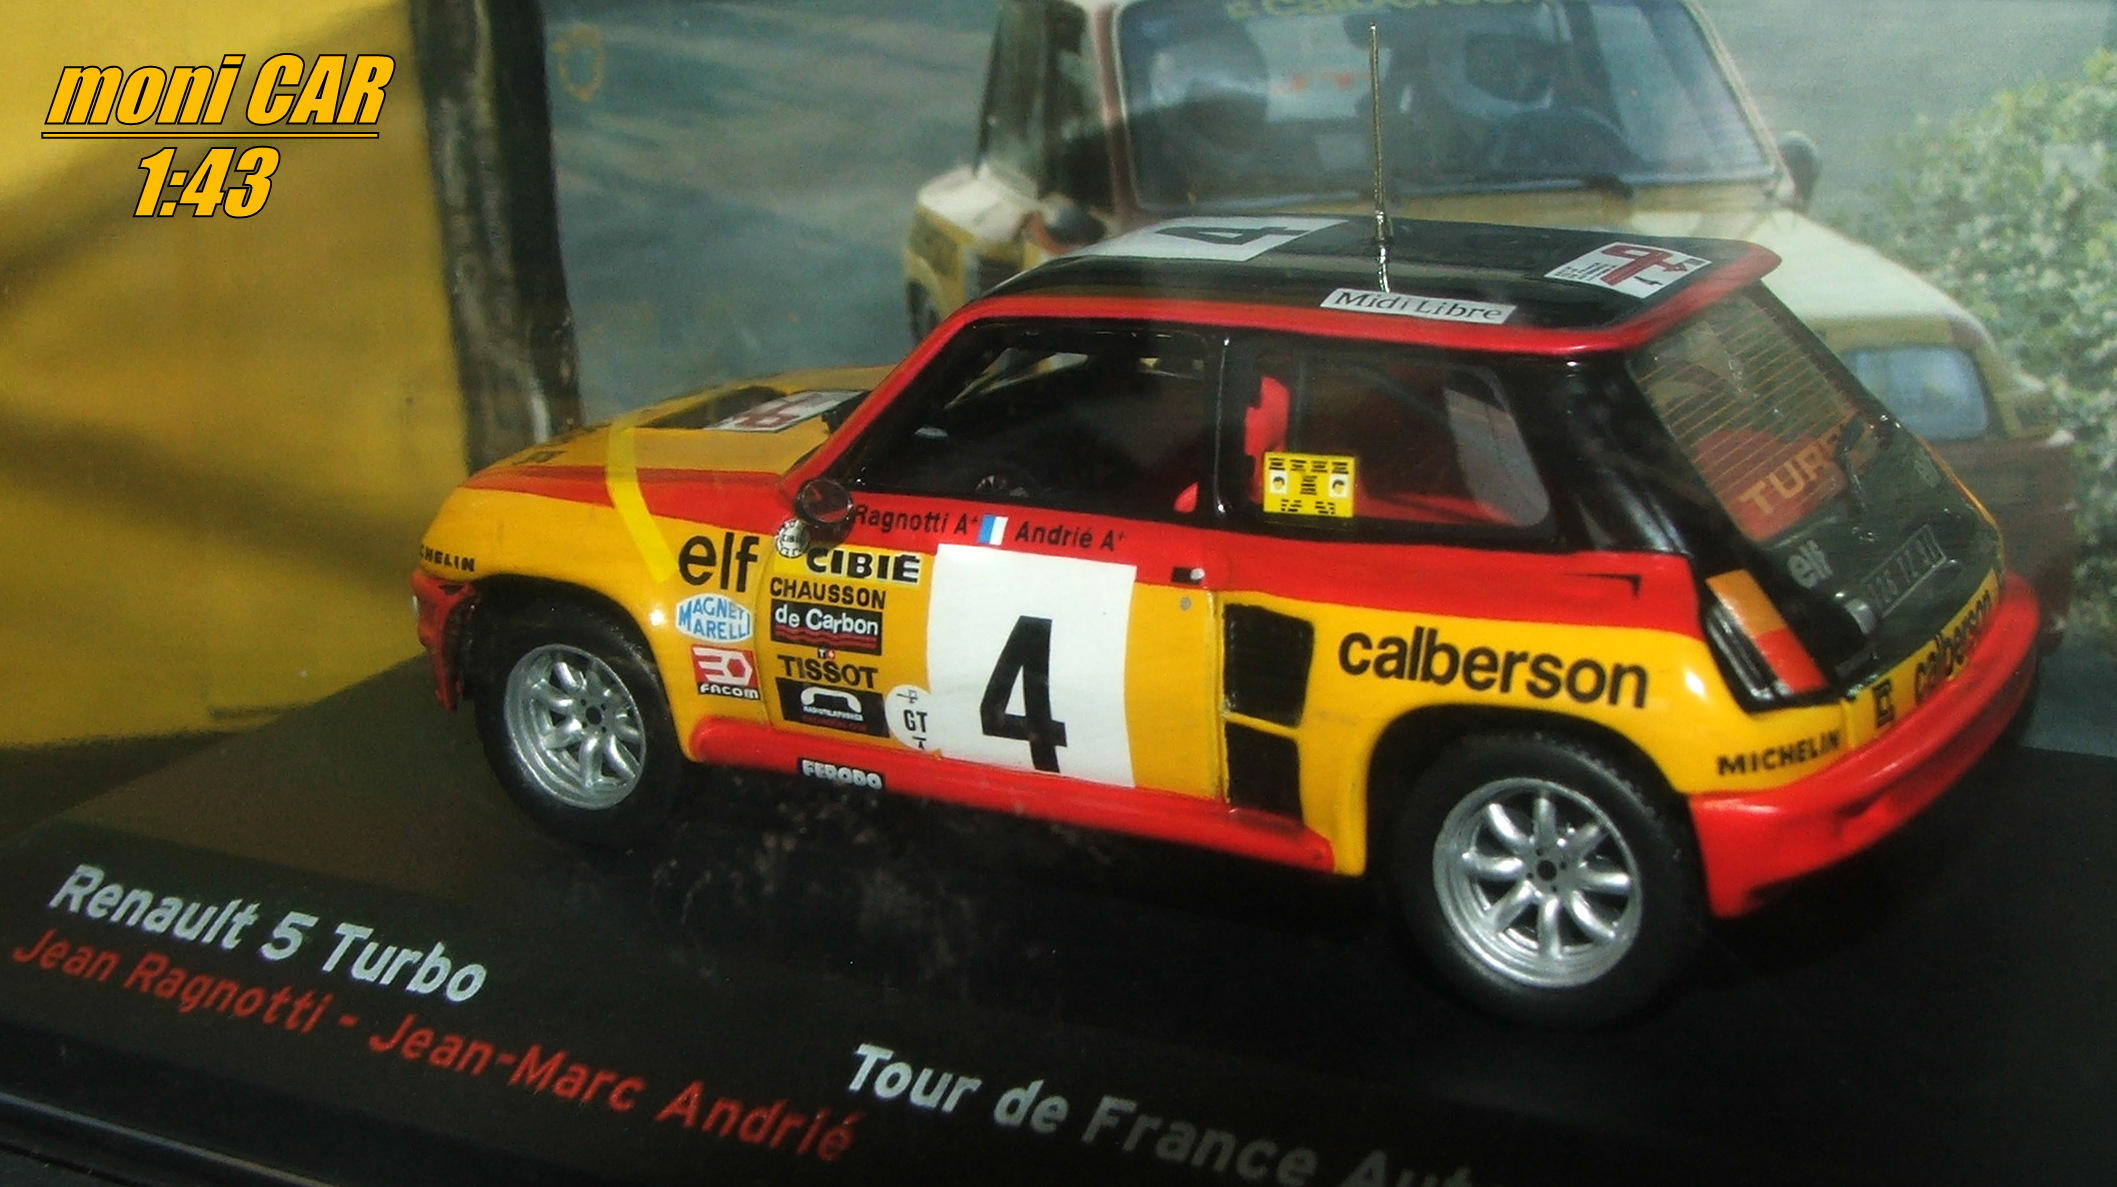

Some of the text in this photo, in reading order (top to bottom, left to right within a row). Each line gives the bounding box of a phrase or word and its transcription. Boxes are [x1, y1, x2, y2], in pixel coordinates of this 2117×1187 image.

[1334, 291, 1502, 321] Midi Libre
[853, 504, 949, 534] Ragnotti
[1015, 520, 1094, 549] Andrié
[678, 531, 760, 593] elf
[806, 547, 920, 583] CIBIÉ
[770, 576, 886, 610] CHAUSSON
[775, 604, 878, 636] de Carbon
[777, 654, 878, 689] TISSOT
[1338, 626, 1648, 709] calberson
[979, 615, 1067, 774] 4
[904, 709, 928, 734] GT
[1716, 729, 1841, 776] MICHELIN
[801, 758, 883, 790] FERODO
[48, 864, 488, 1002] Renault 5 Turbo
[11, 928, 120, 983] Jean
[124, 951, 334, 1034] Ragnotti
[368, 1013, 646, 1112] Jean-Marc
[655, 1080, 867, 1163] Andrié
[848, 1043, 983, 1113] Tour
[993, 1079, 1070, 1134] de
[1081, 1094, 1319, 1187] France
